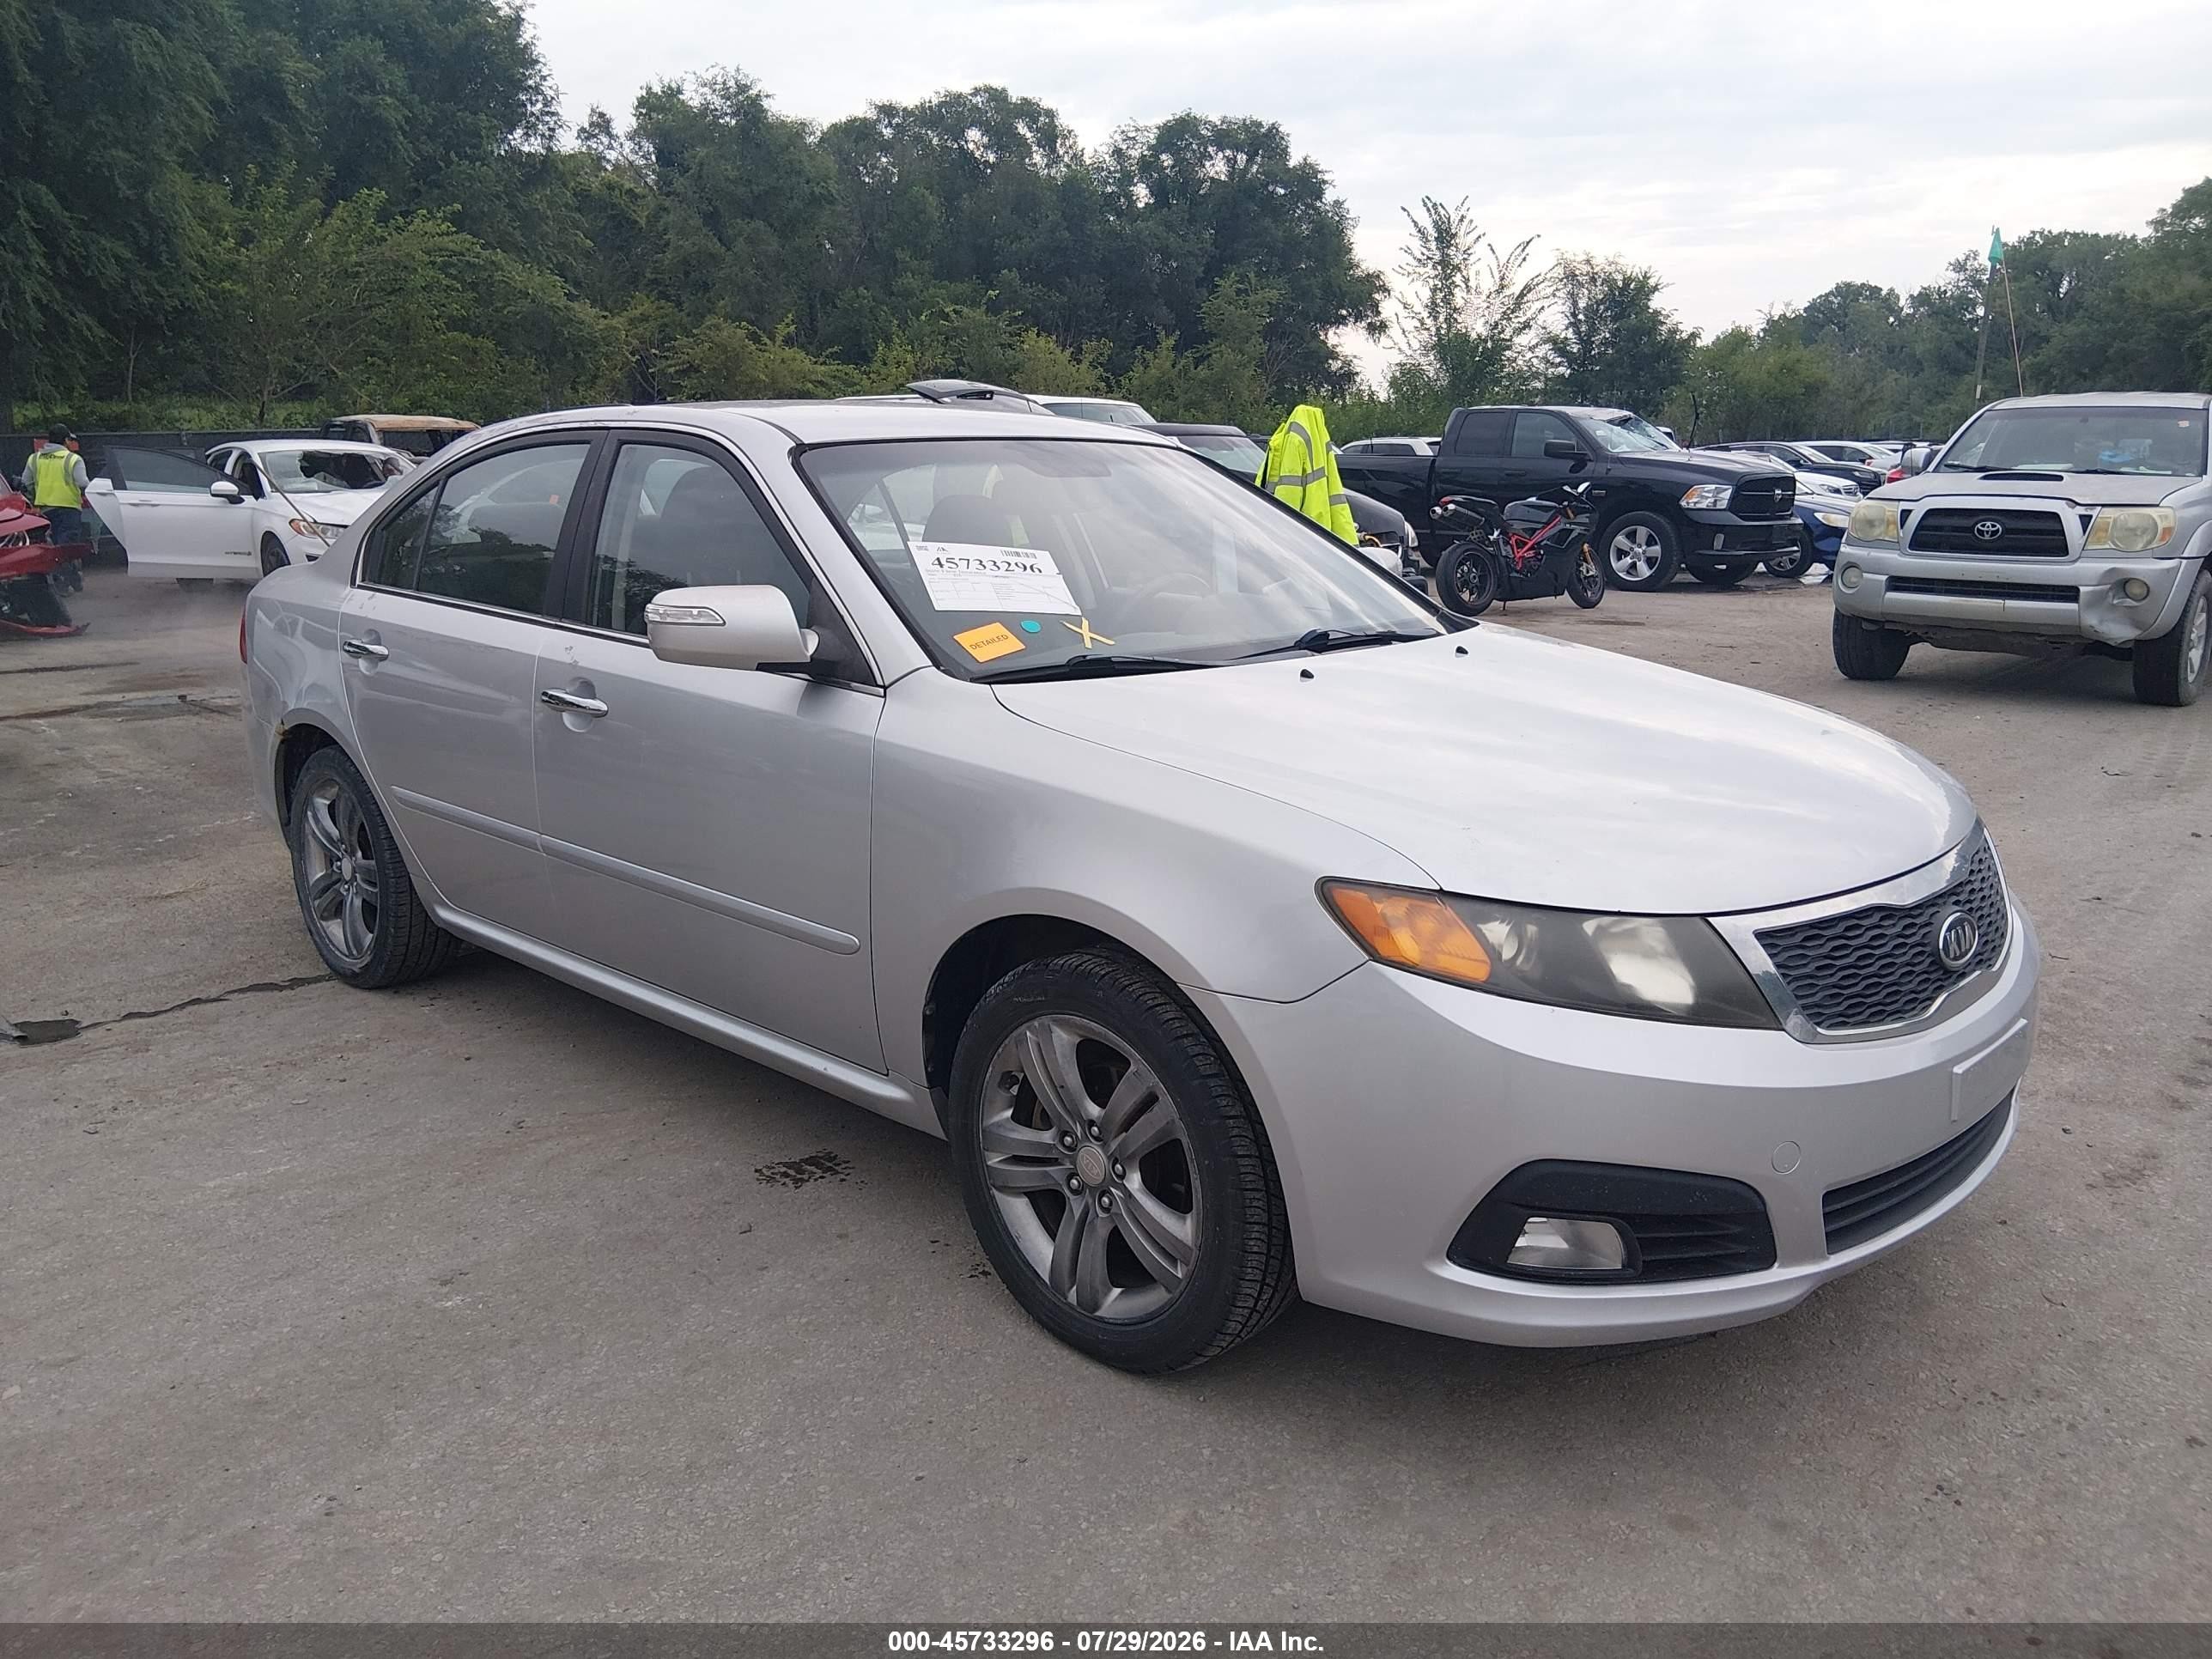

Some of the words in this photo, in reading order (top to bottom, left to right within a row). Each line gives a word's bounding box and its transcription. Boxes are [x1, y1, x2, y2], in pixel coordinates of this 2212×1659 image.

[931, 556, 1042, 574] 45733296
[969, 634, 1009, 650] DETAILED
[1945, 921, 1975, 958] KIA
